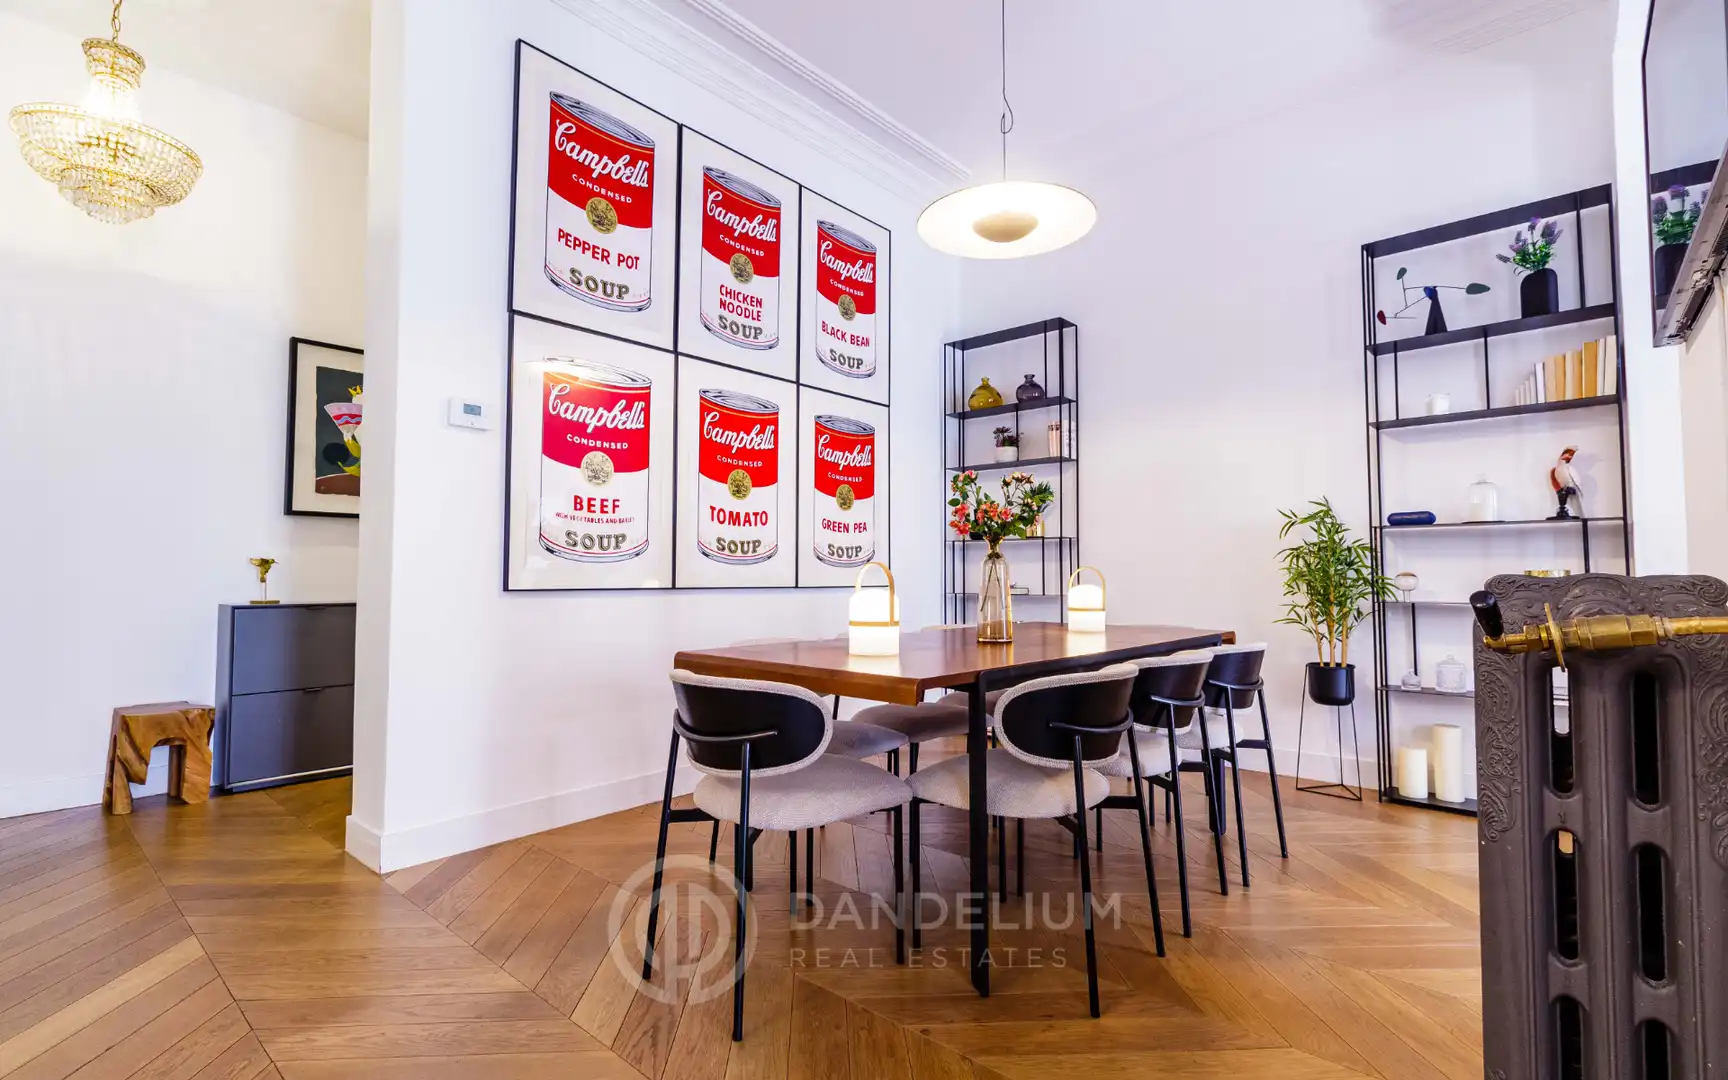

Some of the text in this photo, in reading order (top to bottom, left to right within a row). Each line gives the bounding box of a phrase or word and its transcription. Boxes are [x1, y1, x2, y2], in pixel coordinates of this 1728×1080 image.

[572, 173, 632, 203] CONDENSED
[557, 227, 640, 270] PEPPER POT
[719, 234, 765, 257] CONDENSED
[569, 267, 630, 300] SOUP
[830, 278, 865, 297] CONDENSED
[719, 284, 763, 309] CHICKEN
[719, 297, 762, 322] NOODLE
[718, 314, 763, 340] SOUP
[821, 320, 870, 347] BLACK BEAN
[829, 348, 864, 370] SOUP
[566, 433, 629, 450] CONDENSED
[717, 455, 763, 467] CONDENSED
[828, 472, 863, 482] CONDENSED
[573, 494, 621, 515] BEEF
[709, 505, 769, 527] TOMATO
[821, 518, 868, 534] GREEN PEA
[565, 529, 628, 551] SOUP
[715, 536, 762, 555] SOUP
[828, 543, 863, 559] SOUP
